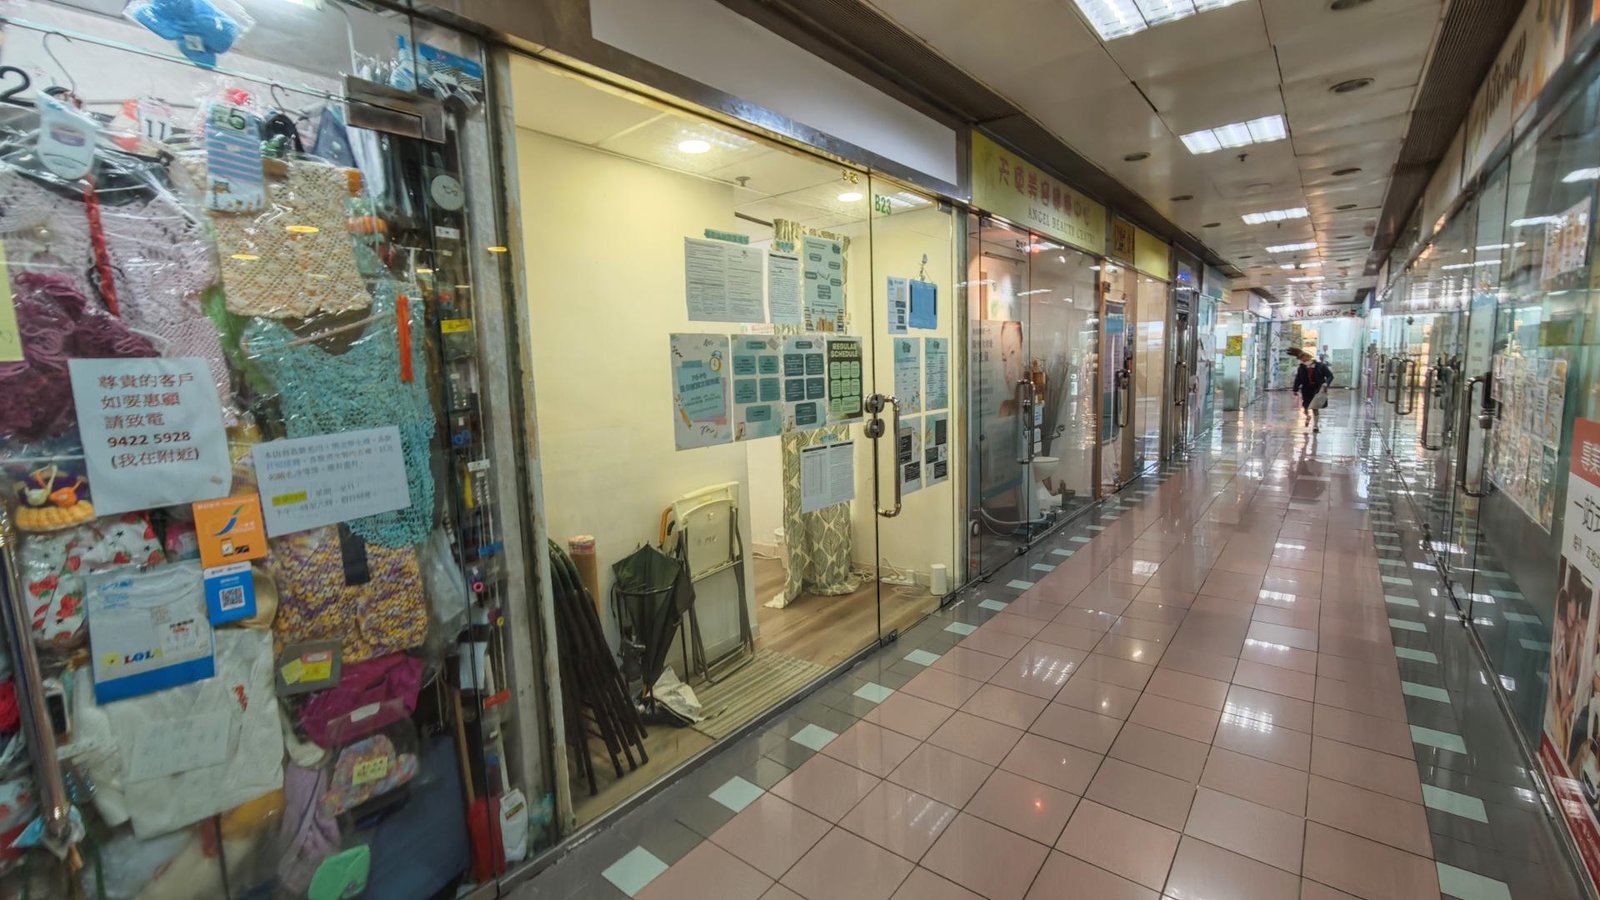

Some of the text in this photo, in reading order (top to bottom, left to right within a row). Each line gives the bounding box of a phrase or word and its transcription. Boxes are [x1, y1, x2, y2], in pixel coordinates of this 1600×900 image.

[874, 194, 892, 216] B23
[1027, 207, 1050, 226] ANGEL
[1052, 217, 1075, 237] BEAUTY
[830, 350, 858, 358] SCHEDULE
[832, 342, 857, 350] REGULAR
[104, 412, 166, 429] 請致電
[107, 431, 191, 448] 9422 5928
